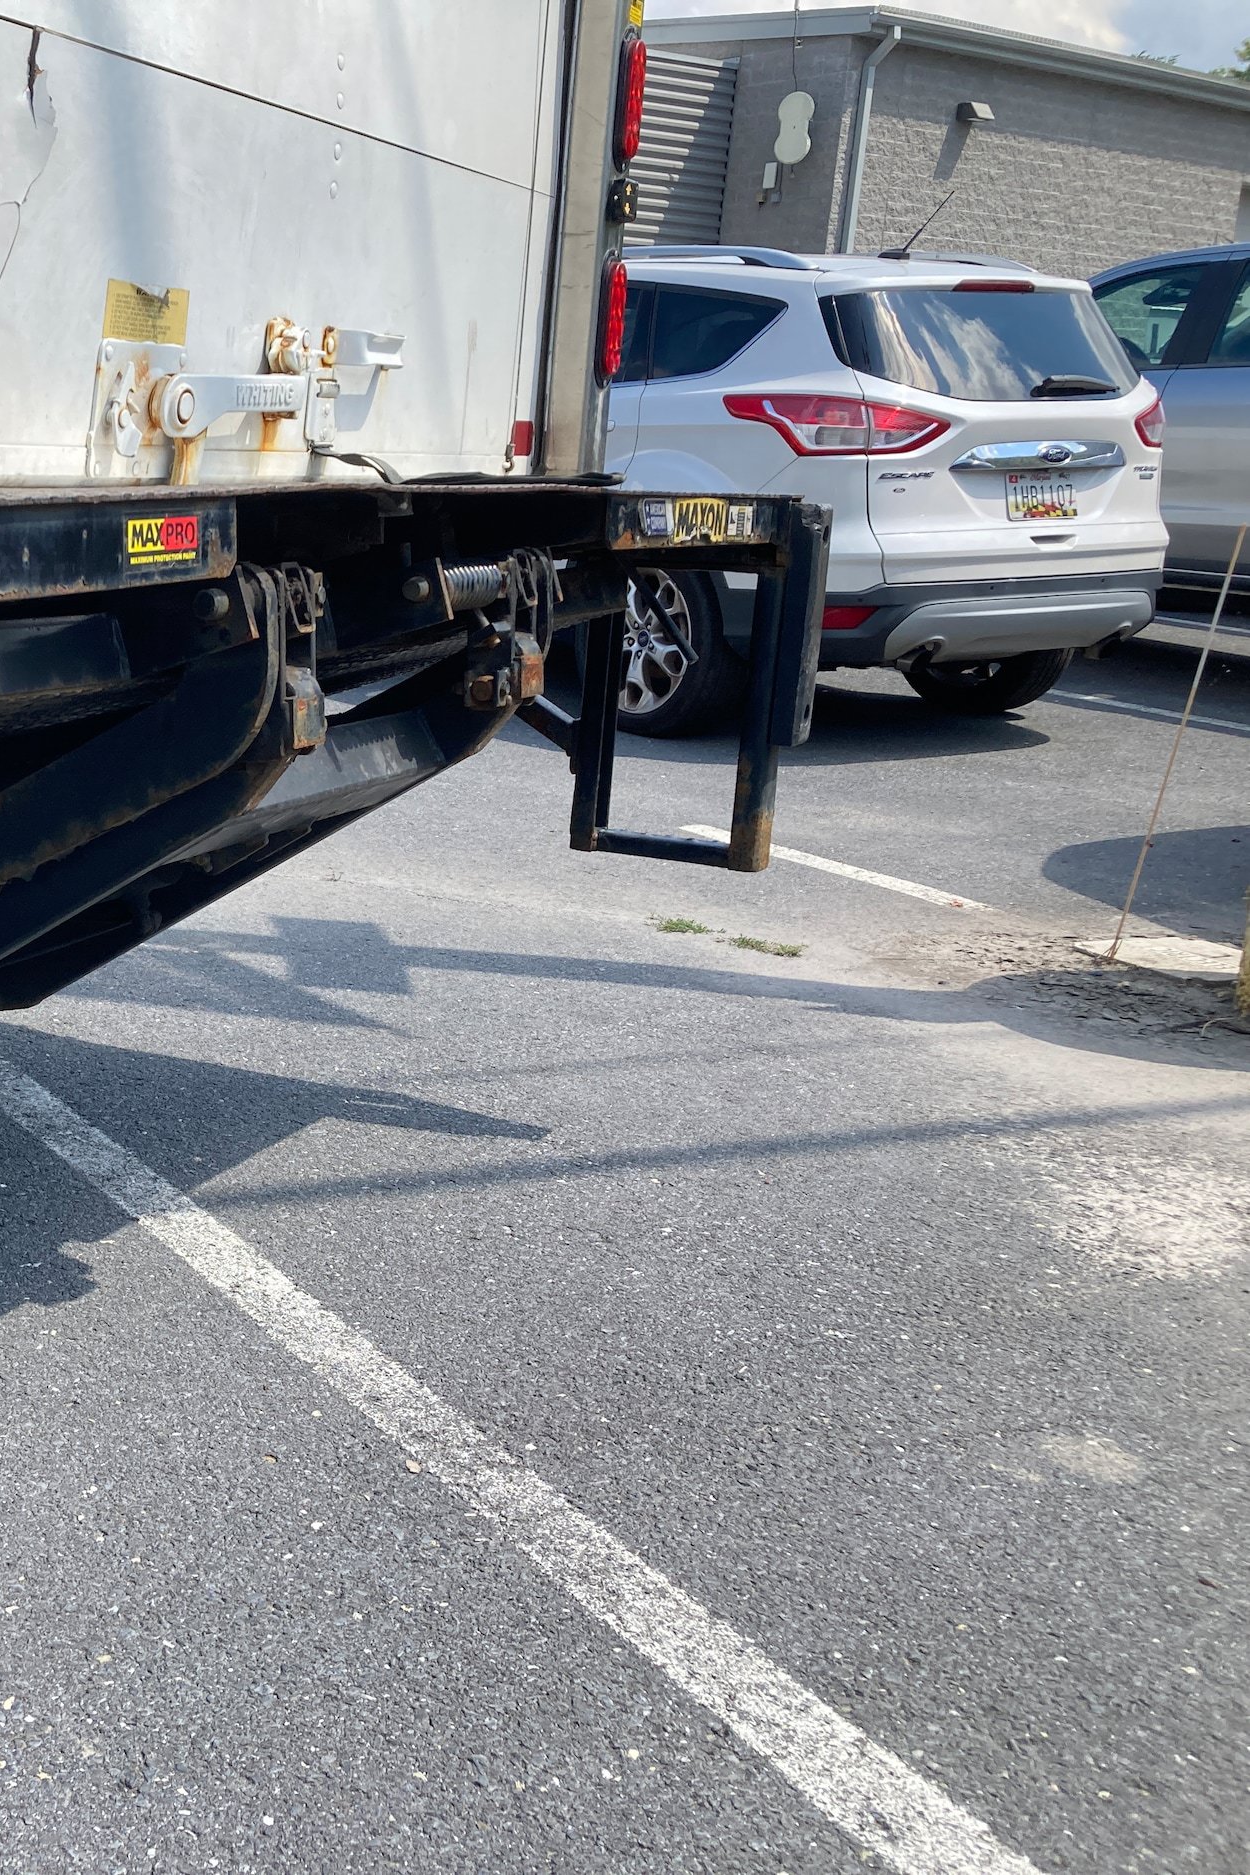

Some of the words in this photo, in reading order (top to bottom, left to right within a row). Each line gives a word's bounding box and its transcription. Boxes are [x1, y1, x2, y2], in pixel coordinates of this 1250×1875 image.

[236, 383, 295, 407] WHITING
[1047, 446, 1068, 461] Ford
[877, 471, 935, 481] ESCAPE
[1012, 483, 1074, 511] 1HB1107
[675, 502, 725, 537] MAXON
[131, 521, 195, 549] MAXPRO
